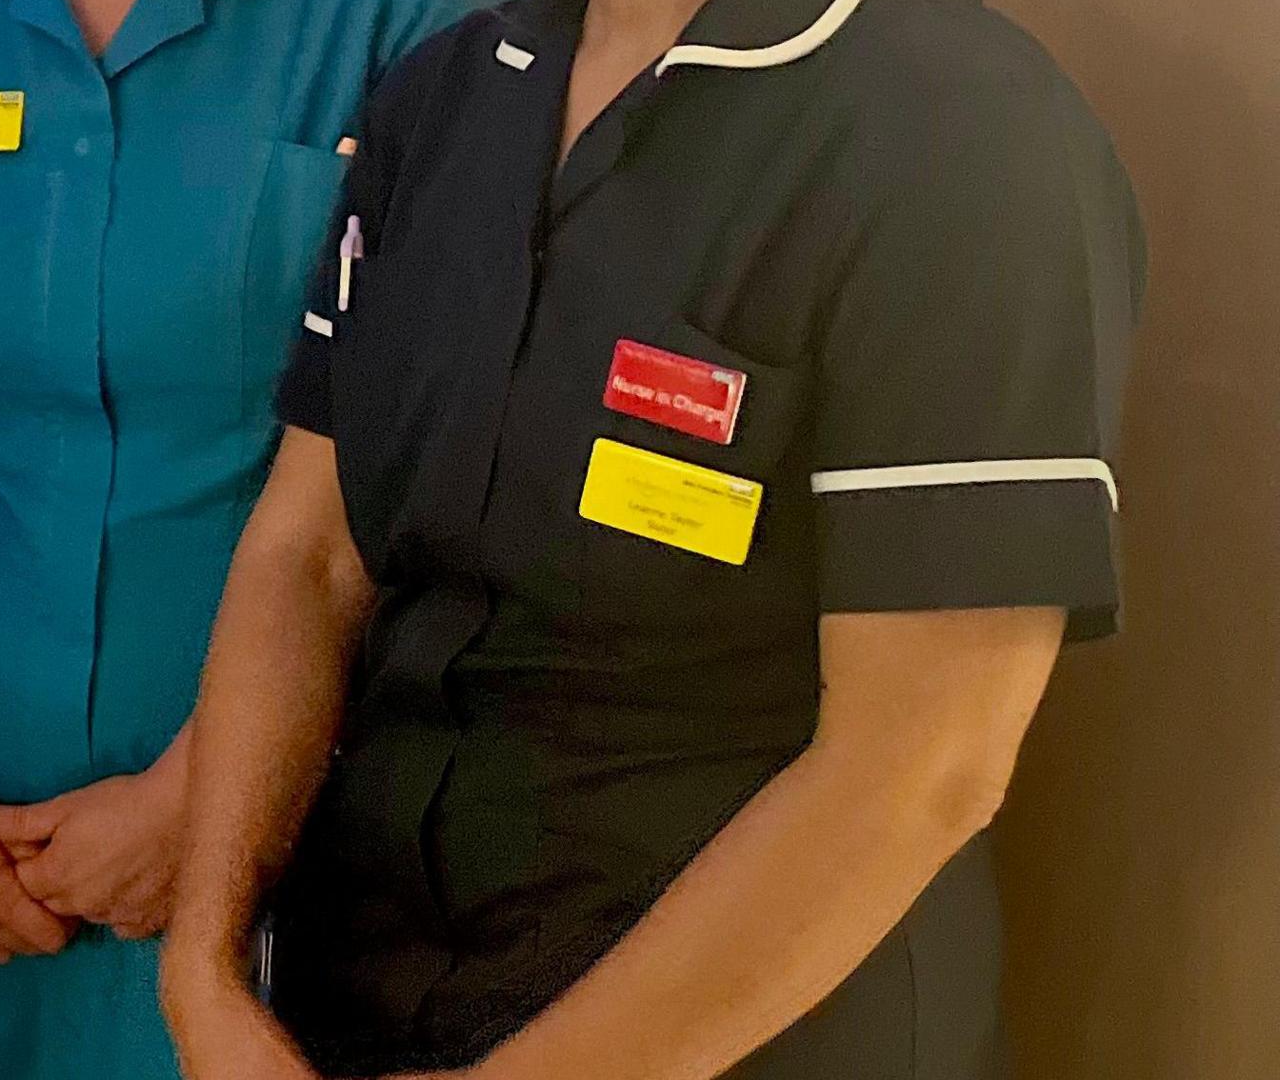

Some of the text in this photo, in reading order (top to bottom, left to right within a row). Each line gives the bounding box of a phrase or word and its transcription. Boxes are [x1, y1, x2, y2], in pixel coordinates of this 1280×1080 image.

[612, 375, 727, 423] Nurse in Charge
